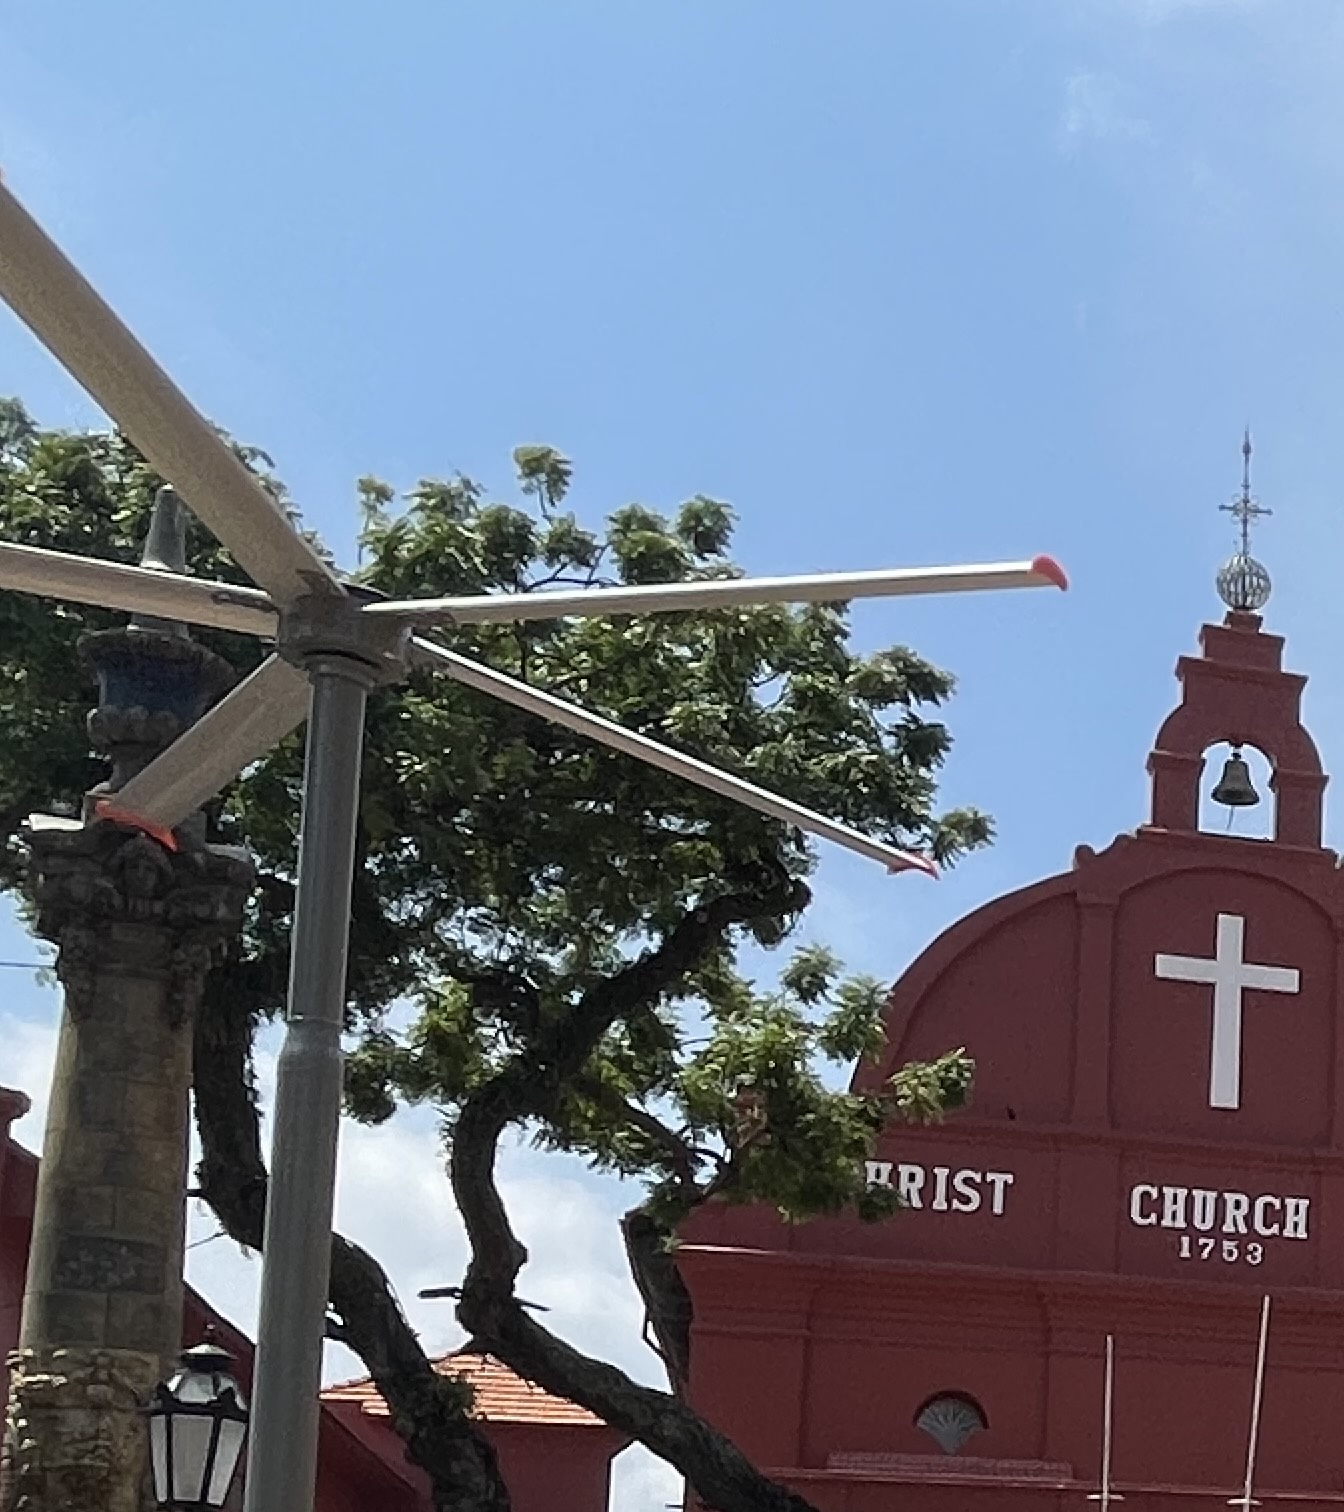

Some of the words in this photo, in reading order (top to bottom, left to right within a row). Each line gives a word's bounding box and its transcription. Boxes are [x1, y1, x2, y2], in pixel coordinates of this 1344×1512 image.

[864, 1160, 1014, 1216] HRIST
[1130, 1184, 1310, 1240] CHURCH
[1178, 1235, 1264, 1266] 1753
